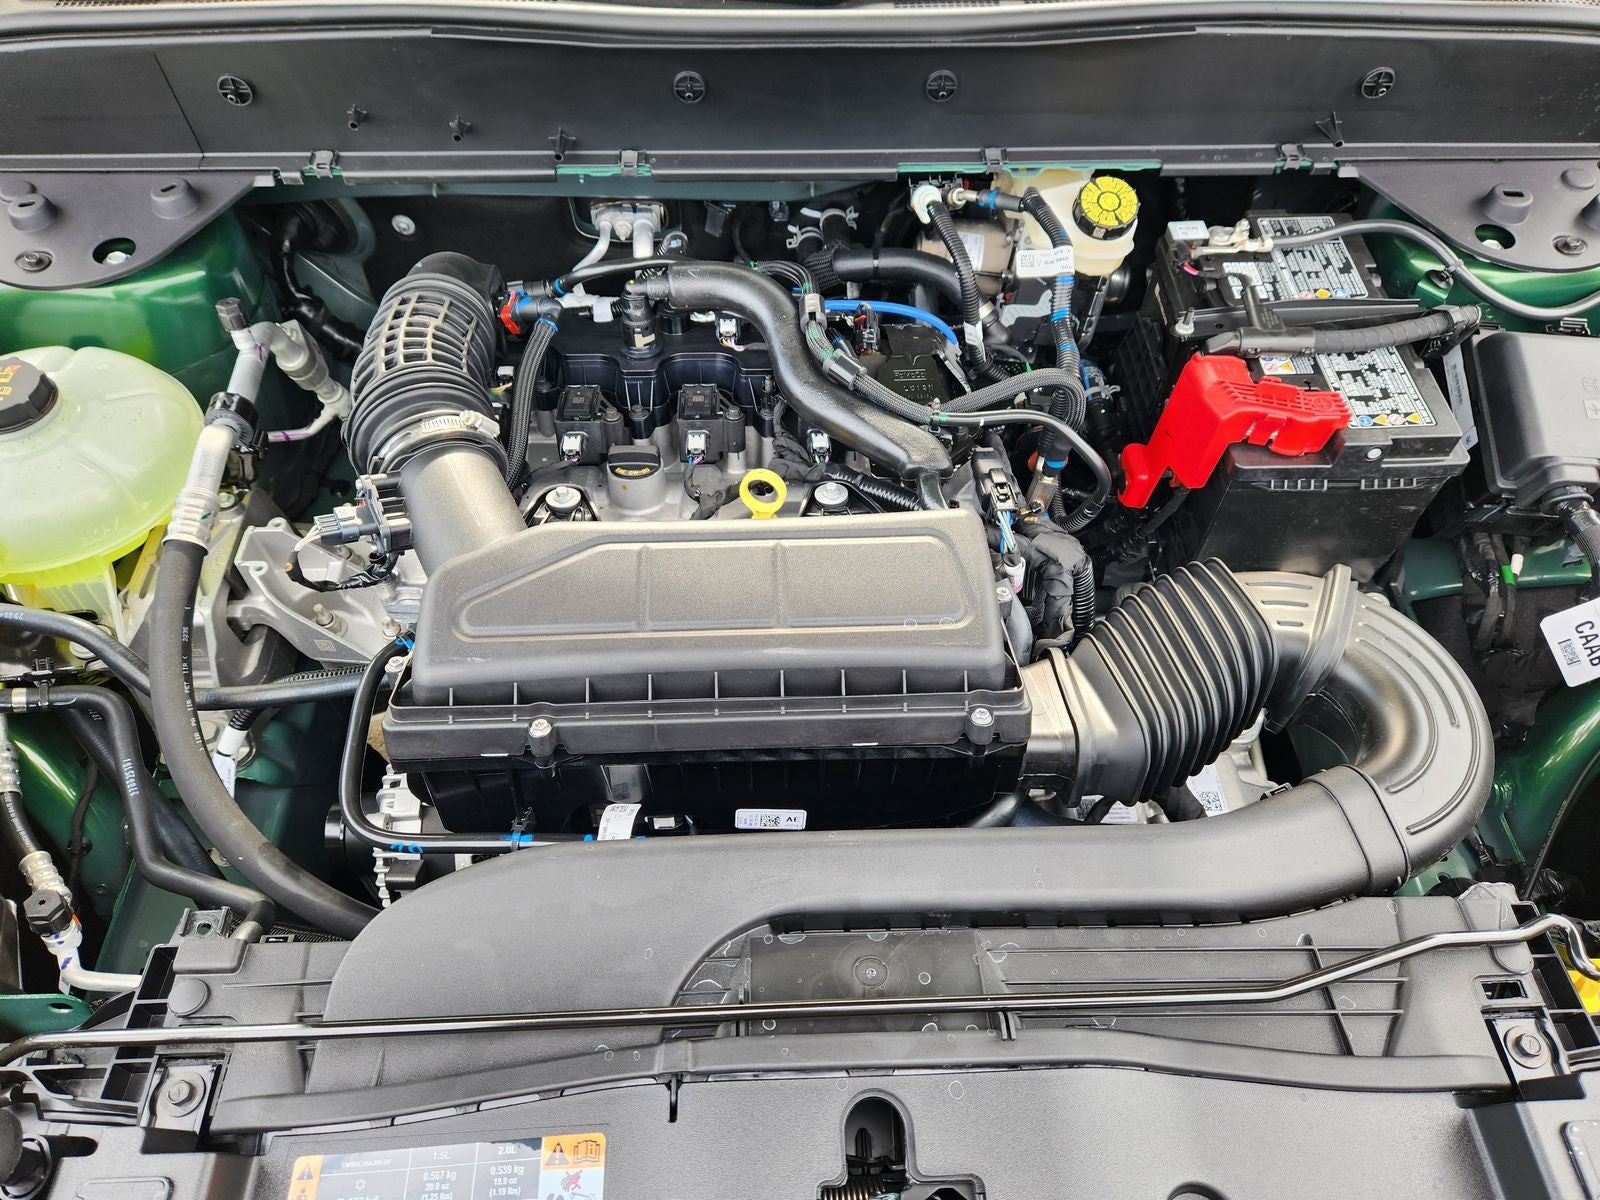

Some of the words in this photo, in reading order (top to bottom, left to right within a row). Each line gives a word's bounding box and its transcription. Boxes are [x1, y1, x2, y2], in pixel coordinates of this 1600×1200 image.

[433, 1150, 451, 1161] 1.5L
[497, 1145, 517, 1155] 2.0L
[423, 1171, 446, 1181] 0.567
[446, 1170, 457, 1181] kg
[490, 1165, 512, 1176] 0.539
[513, 1165, 525, 1176] kg
[507, 1186, 521, 1196] lbs)
